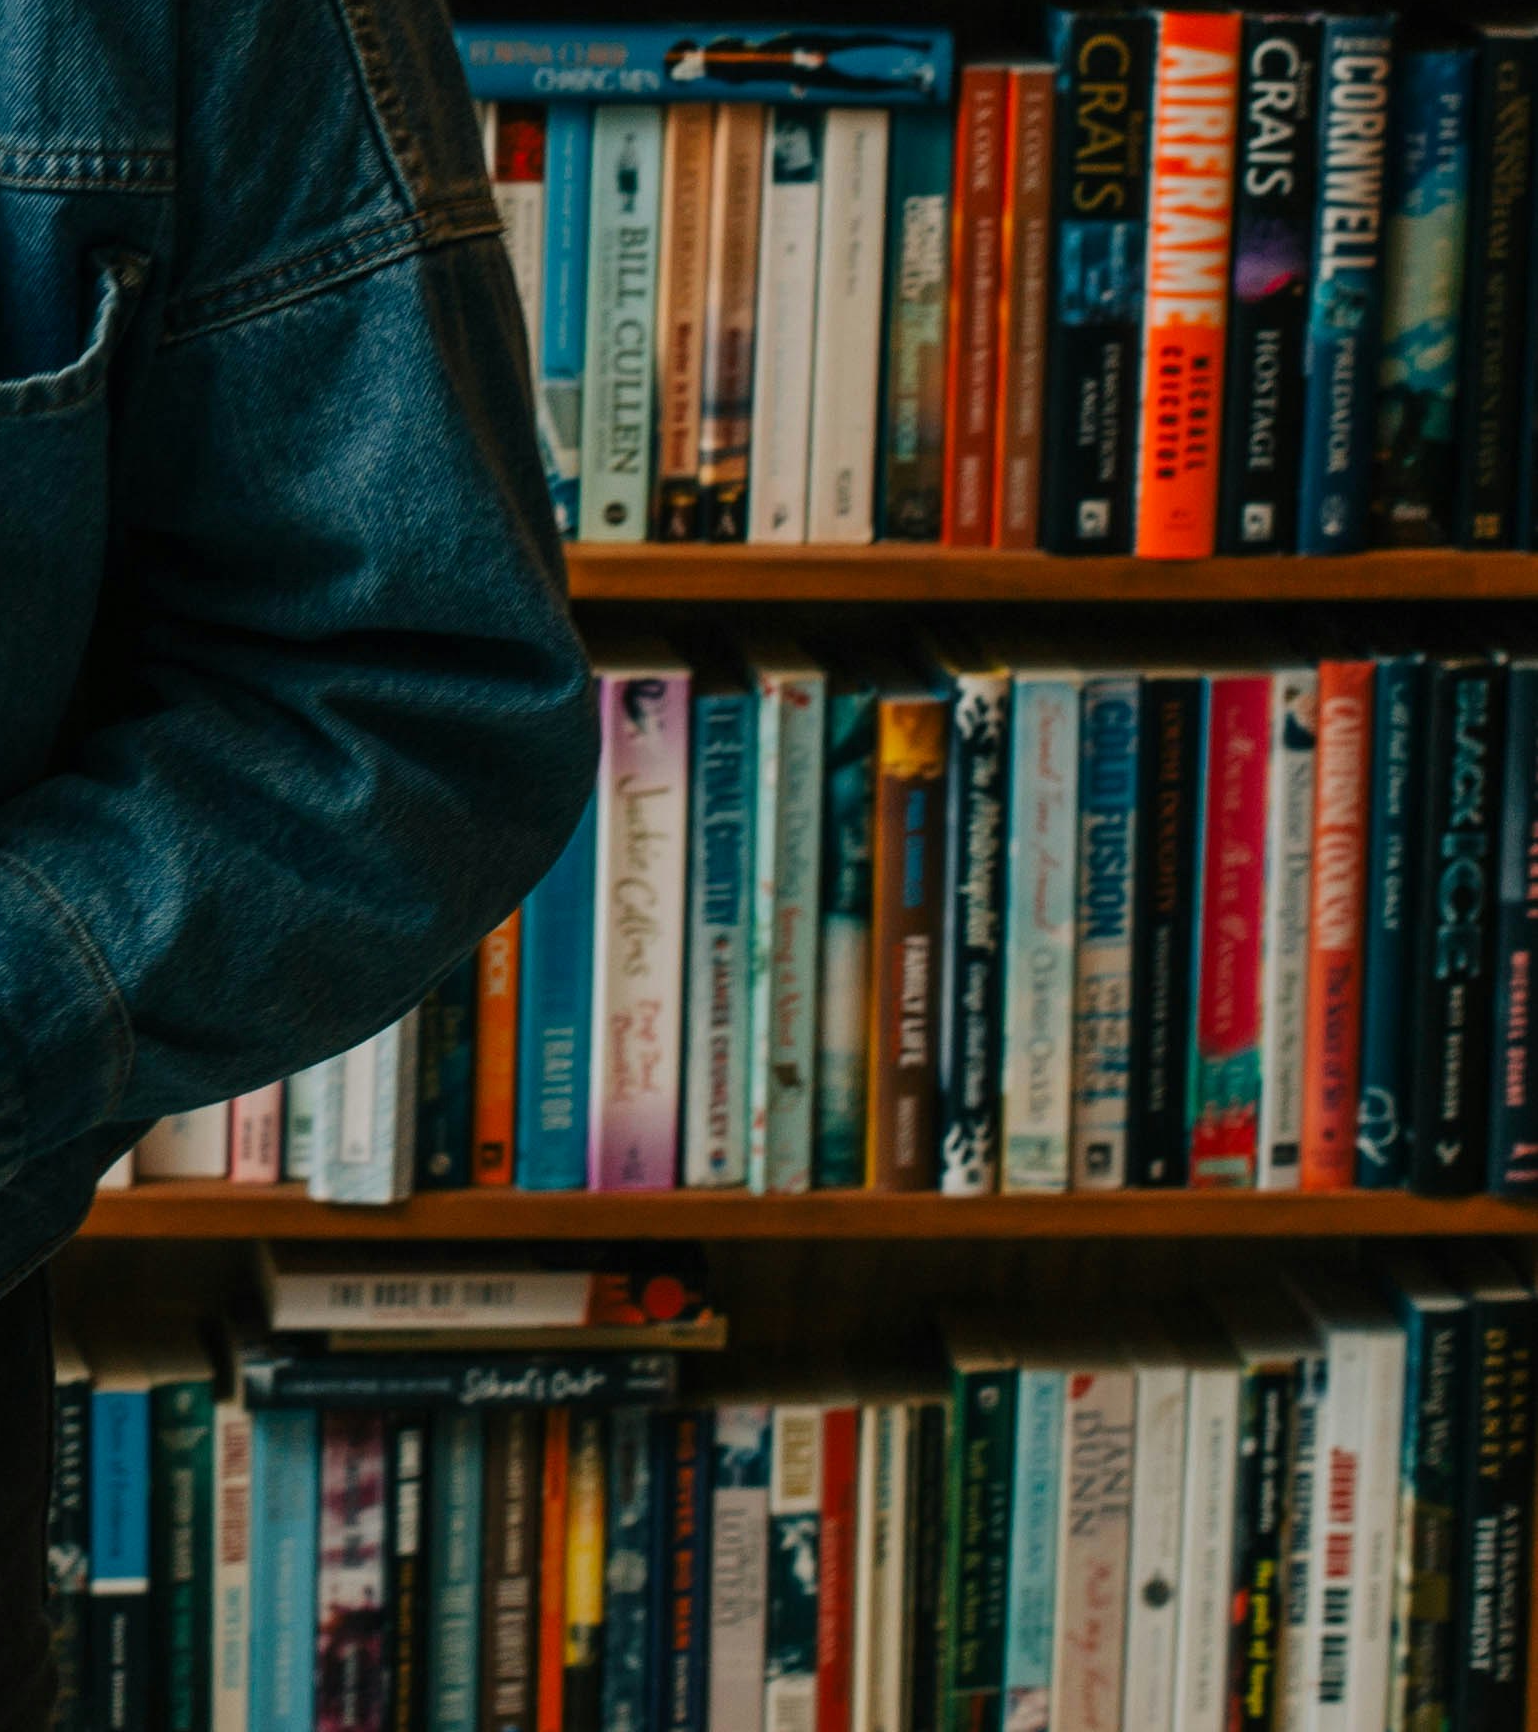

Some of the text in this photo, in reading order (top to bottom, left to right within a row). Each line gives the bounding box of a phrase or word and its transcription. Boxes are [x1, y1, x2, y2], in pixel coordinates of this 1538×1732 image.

[1072, 34, 1130, 212] CRAIS
[1152, 46, 1233, 328] AIRFRAME
[609, 226, 648, 476] BILL CULLEN
[1245, 38, 1299, 470] CRAIS HOSTAGE
[1317, 55, 1391, 475] CORNWELL PREDATOR
[1157, 347, 1182, 481] CRICHTON
[1186, 356, 1210, 472] MICHAEL
[611, 772, 671, 978] Jackie Collins
[1084, 700, 1132, 941] COLD FUSION
[1435, 679, 1490, 980] BLACK ICE
[899, 935, 929, 1067] FAMILY LIFE
[1070, 1409, 1101, 1537] DUNN
[1099, 1423, 1132, 1525] JANE
